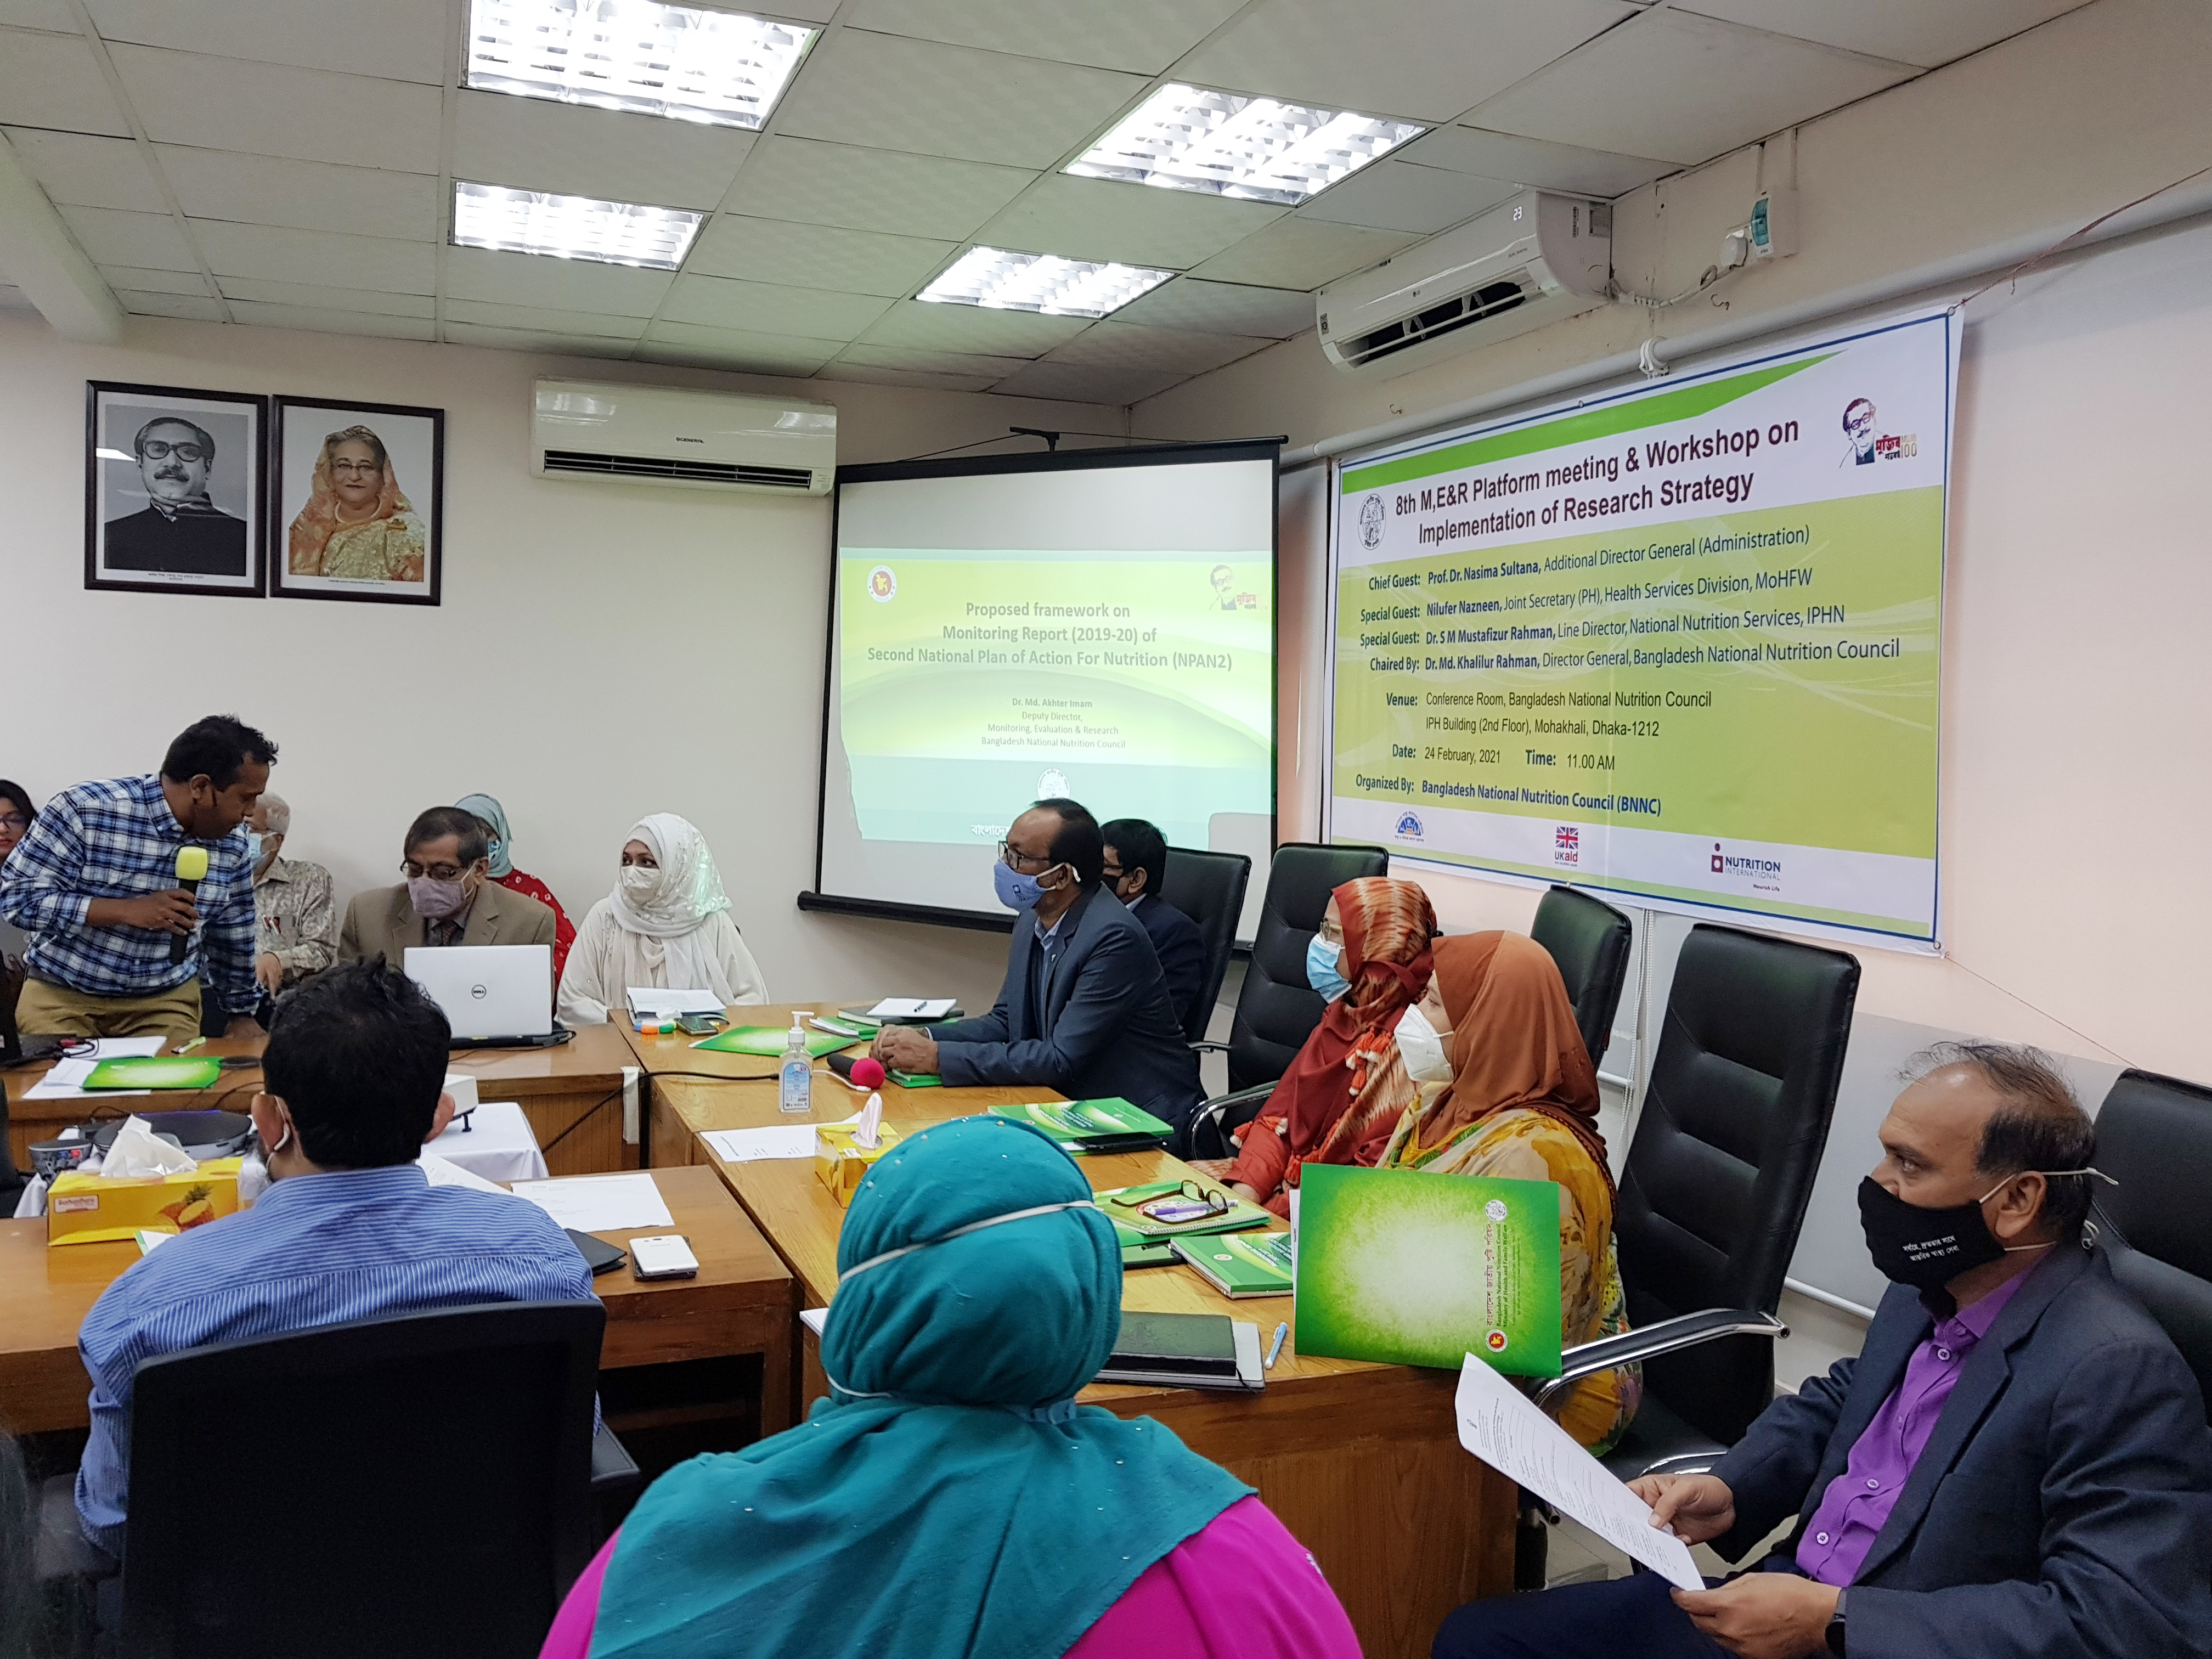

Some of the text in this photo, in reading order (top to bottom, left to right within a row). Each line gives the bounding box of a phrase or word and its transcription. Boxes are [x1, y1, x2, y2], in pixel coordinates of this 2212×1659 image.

[1513, 206, 1522, 221] 23
[1396, 493, 1416, 516] 8th
[1421, 482, 1468, 513] M,E&R
[1473, 472, 1540, 501] Platform
[1546, 455, 1618, 488] meeting
[1626, 447, 1640, 472] &
[1646, 428, 1759, 468] Workshop
[1768, 420, 1798, 445] on
[1419, 507, 1535, 547] Implementation
[1541, 499, 1559, 525] of
[1564, 484, 1652, 522] Research
[1660, 472, 1754, 506] Strategy
[1369, 524, 1809, 591] Chief Guest: Prof. Dr. Nasima Sultana, Additional Director General (Administration)
[1361, 567, 1813, 625] Special Guest: Nilufer Nazneen, Joint Secretary (PH), Health Services Division, MoHFW
[966, 601, 1130, 619] Proposed framework on
[943, 625, 1157, 646] Monitoring Report (2019-20) of
[1360, 604, 1844, 650] Special Guest: Dr. S M Mustafizur Rahman, Line Director, National Nutrition Services, IPHN
[867, 647, 1232, 672] Second National Plan of Action For Nutrition (NPAN2)
[1370, 637, 1899, 674] Chaired By: Dr. Md. Khalilur Rahman, Director General, Bangladesh National Nutrition Council
[1012, 698, 1092, 708] Dr. Md. Akhter Imam
[1386, 691, 1711, 709] Venue: Conference Room, Bangladesh National Nutrition Council
[1022, 711, 1082, 723] Deputy Director,
[1426, 716, 1660, 737] IPH Building (2nd Floor), Mohakhali, Dhaka-1212
[988, 723, 1119, 735] Monitoring, Evaluation & Research
[981, 736, 1126, 748] Bangladesh National Nutrition Council
[1392, 743, 1615, 771] Date: 24 February, 2021 Time: 11.00 AM
[1356, 774, 1661, 817] Organized By: Bangladesh National Nutrition Council (BNNC)
[1725, 856, 1781, 873] NUTRITION
[1725, 867, 1781, 881] INTERNATIONAL
